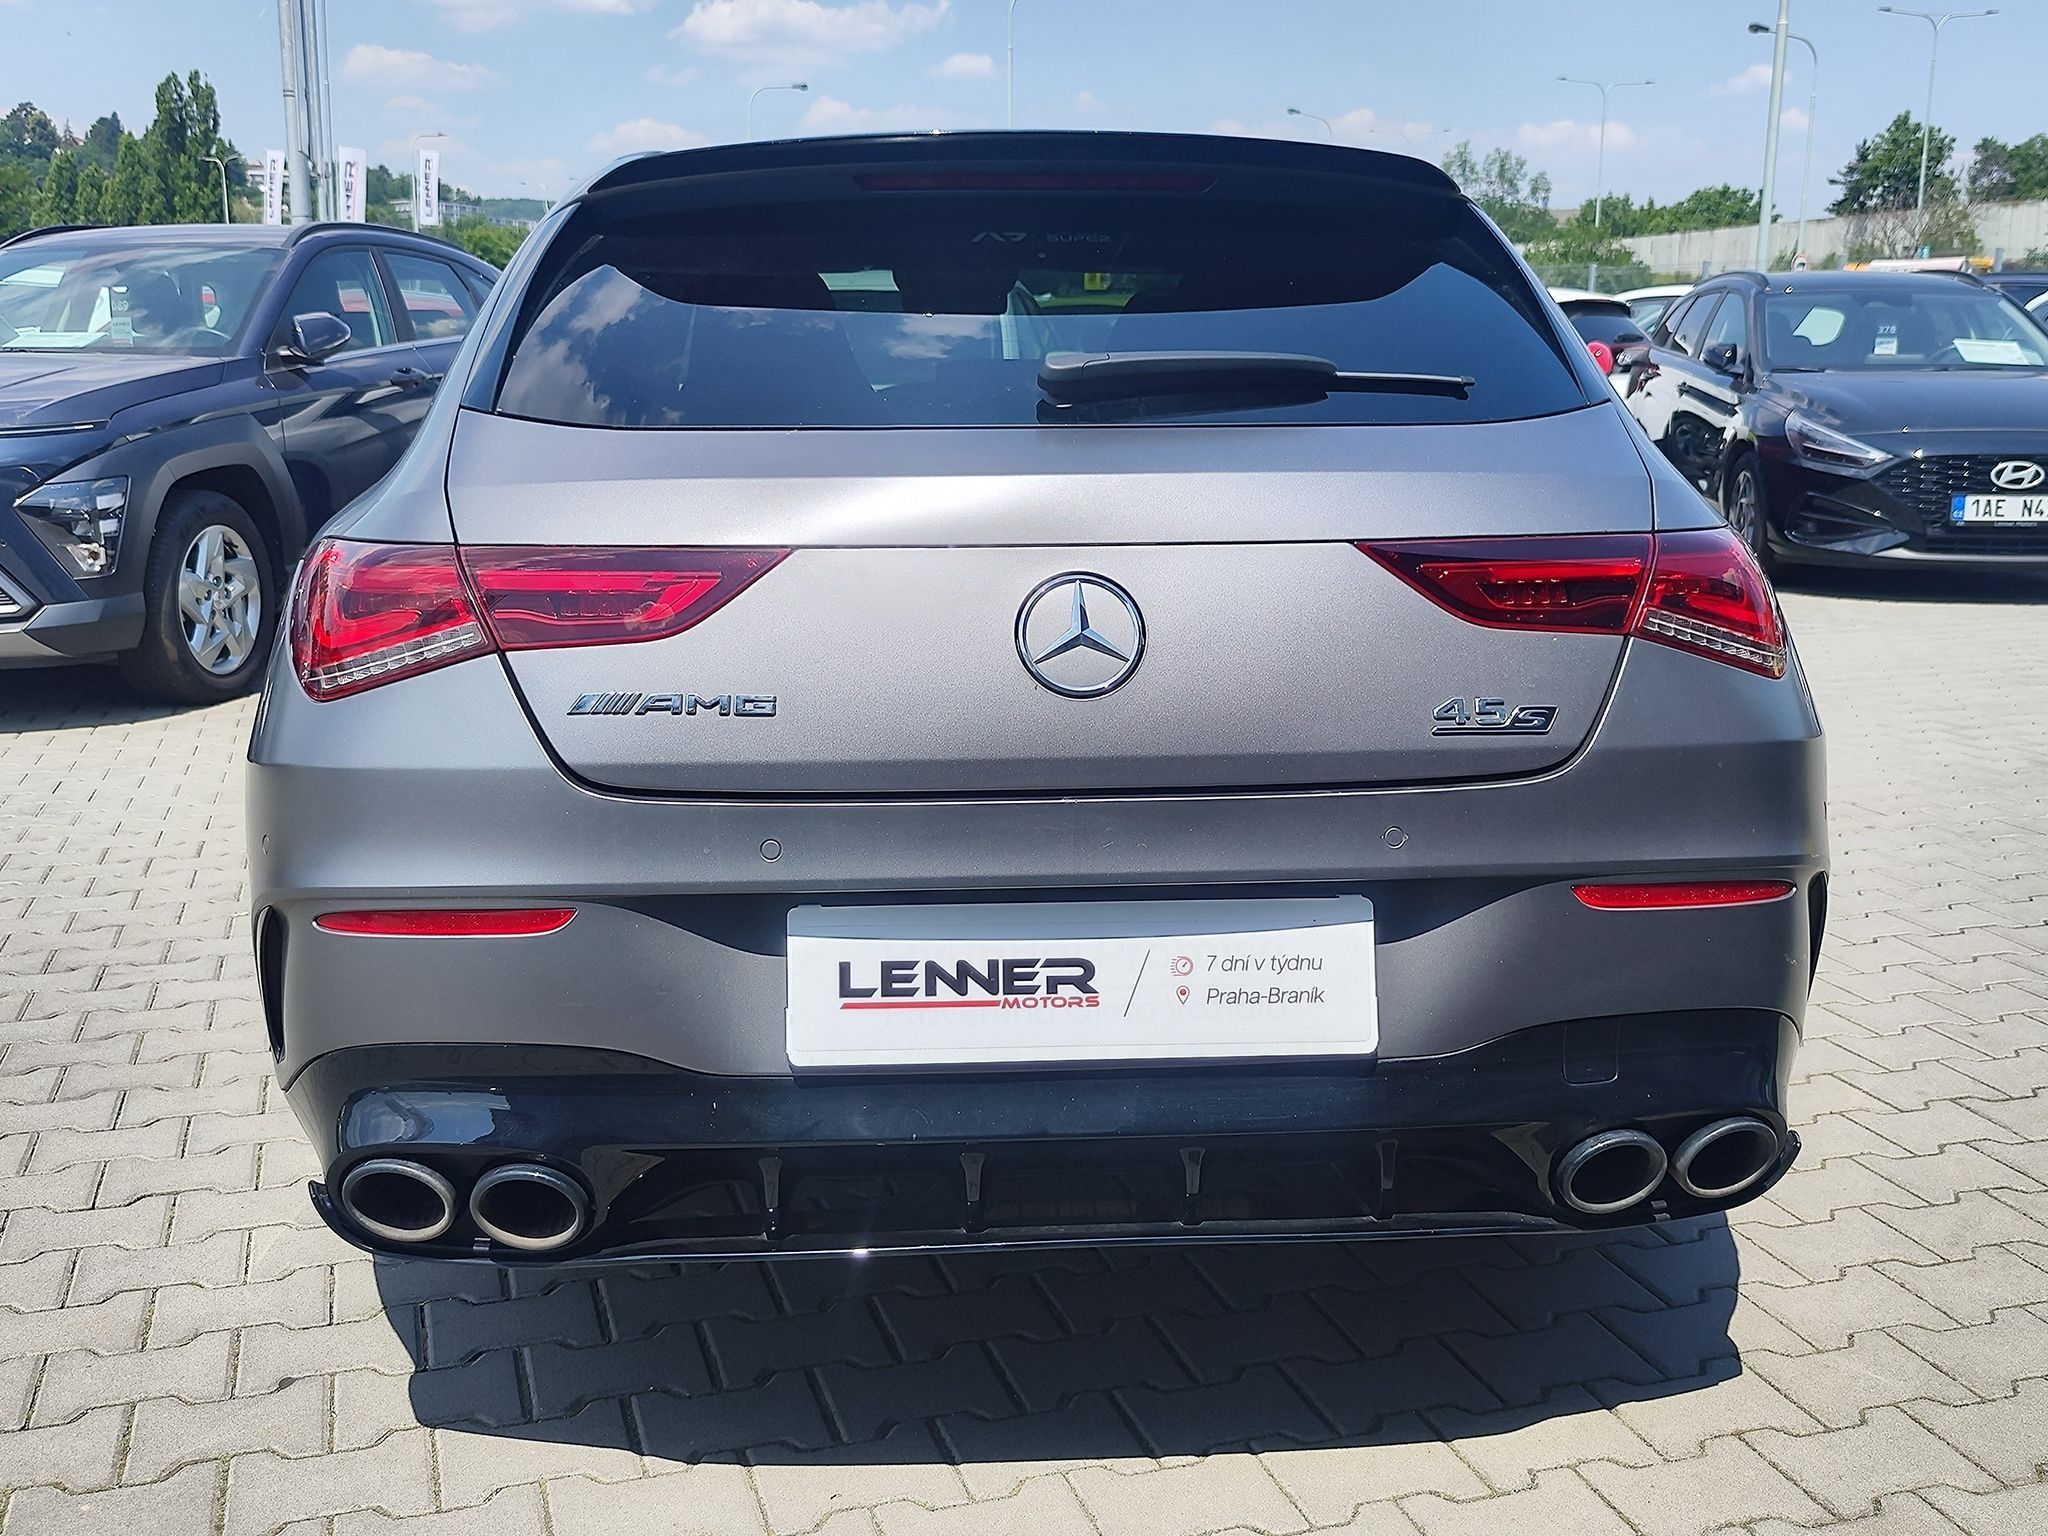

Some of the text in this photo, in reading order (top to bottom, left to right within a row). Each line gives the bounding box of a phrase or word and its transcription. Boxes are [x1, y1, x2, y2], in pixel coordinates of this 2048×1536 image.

[1971, 499, 2048, 517] 1AE N4
[633, 692, 778, 718] AMG
[1206, 954, 1218, 972] 7
[1221, 954, 1251, 972] dní
[1254, 958, 1266, 971] v
[1270, 953, 1323, 975] týdnu
[839, 958, 1100, 998] LENNER
[1001, 995, 1100, 1010] MOTORS
[1206, 986, 1325, 1005] Praha-Braník
